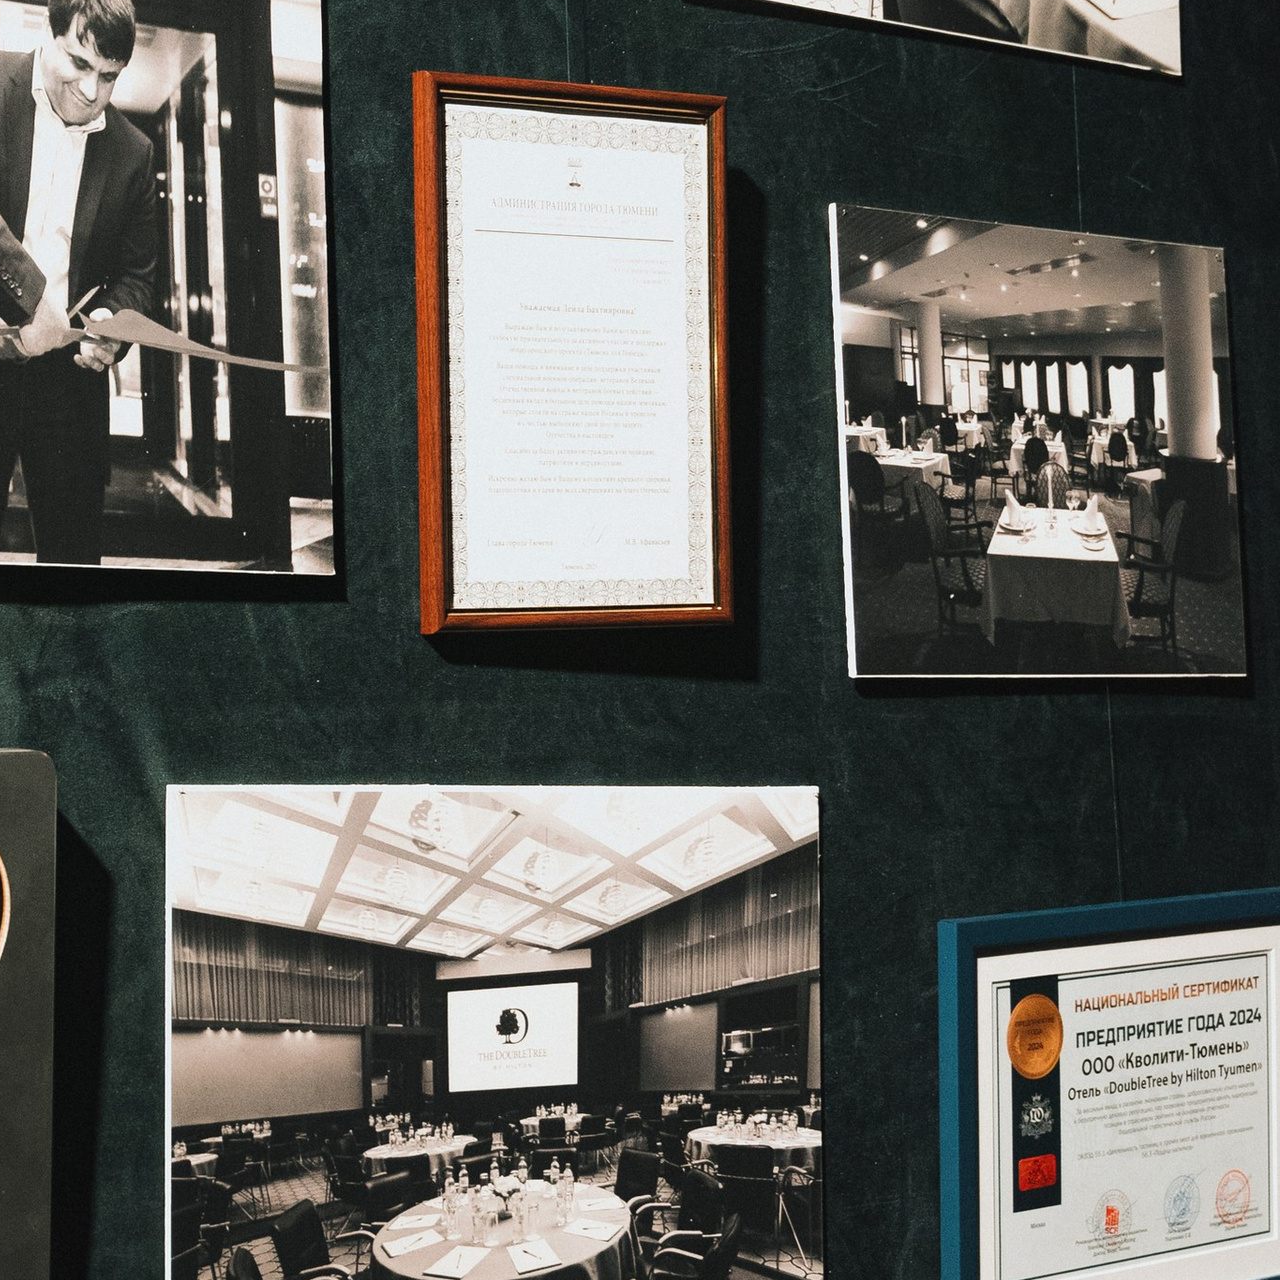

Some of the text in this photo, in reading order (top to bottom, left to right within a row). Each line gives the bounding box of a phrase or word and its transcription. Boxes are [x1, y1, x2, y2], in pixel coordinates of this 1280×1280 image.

[492, 198, 658, 216] АДМИНИСТРАЦИЯ ГОРОДА ТЮМЕНИ
[1074, 976, 1260, 1012] НАЦИОНАЛЬНЫЙ СЕРТИФИКАТ
[1076, 1008, 1262, 1048] ПРЕДПРИЯТИЕ ГОДА 2024
[478, 1052, 494, 1062] THE
[1082, 1040, 1250, 1076] ООО «Кволити-Тюмень»
[1068, 1086, 1101, 1101] Отель
[1104, 1073, 1168, 1095] «DoubleTree
[1171, 1072, 1183, 1086] by
[1186, 1066, 1216, 1082] Hilton
[1218, 1061, 1262, 1080] Tyumen»
